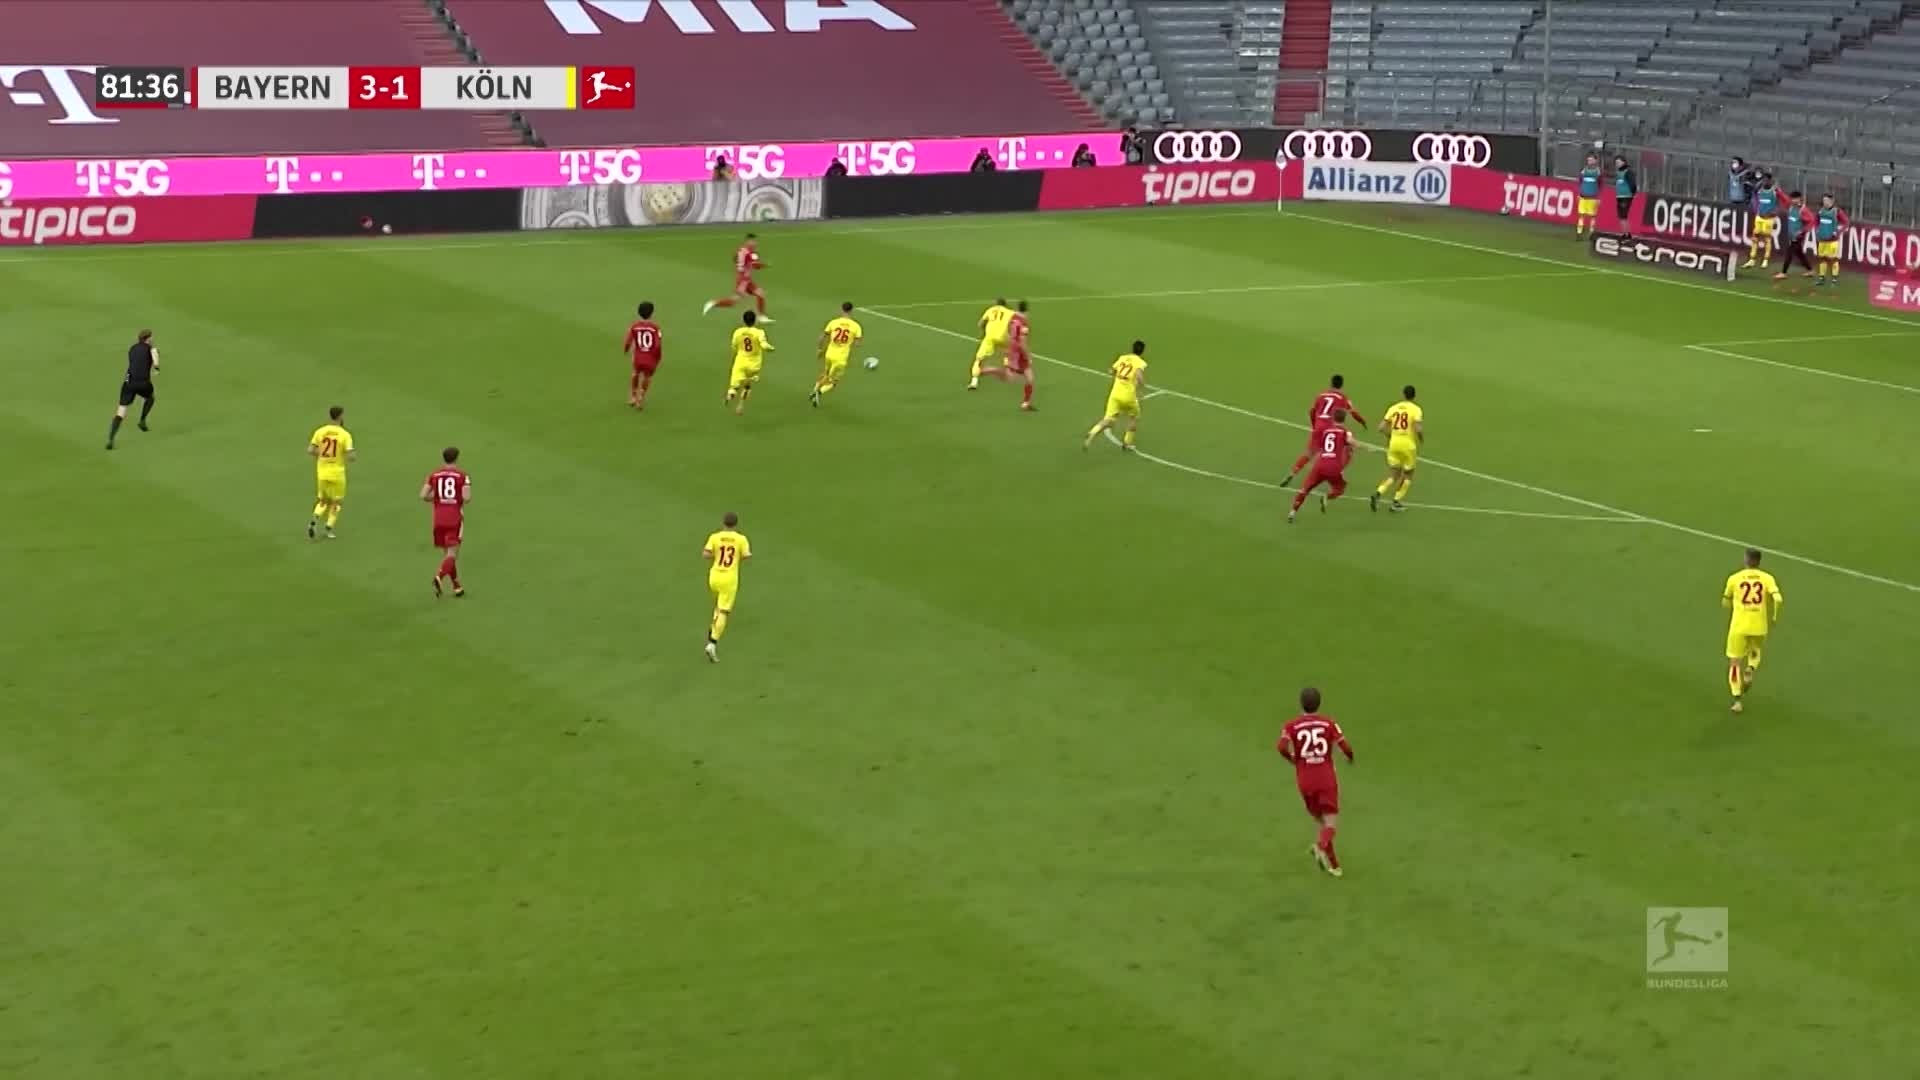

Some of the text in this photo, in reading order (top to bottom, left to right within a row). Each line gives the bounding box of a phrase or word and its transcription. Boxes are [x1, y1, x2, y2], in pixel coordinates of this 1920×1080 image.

[1308, 167, 1407, 194] Allianz
[1653, 199, 1781, 250] OFFIZIELLR
[1595, 237, 1722, 273] e-tron
[637, 331, 653, 351] 10
[744, 337, 753, 352] 8
[834, 327, 850, 344] 26
[1323, 397, 1335, 416] 7
[1392, 411, 1409, 430] 28
[322, 438, 338, 458] 21
[1324, 433, 1337, 453] 6
[438, 477, 456, 499] 18
[719, 545, 735, 567] 13
[1740, 581, 1763, 604] 23
[1297, 727, 1328, 758] 25
